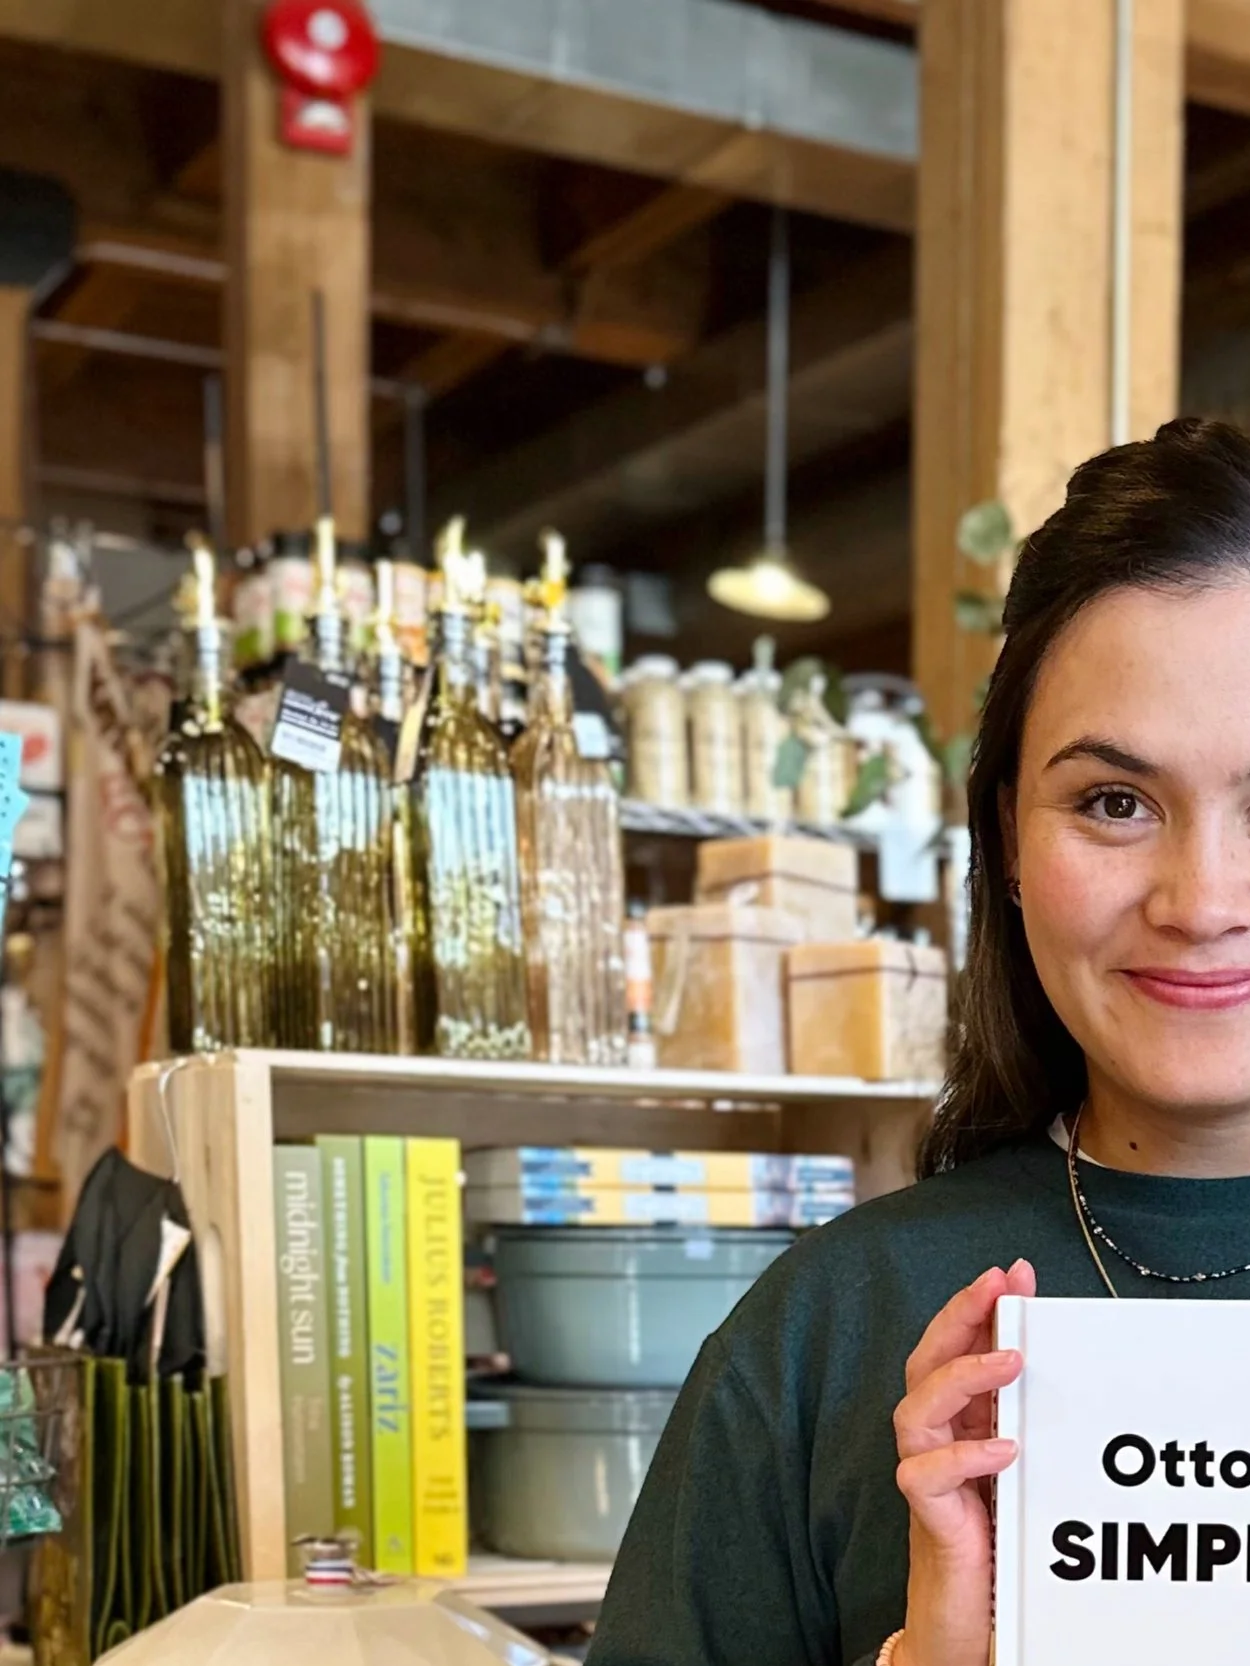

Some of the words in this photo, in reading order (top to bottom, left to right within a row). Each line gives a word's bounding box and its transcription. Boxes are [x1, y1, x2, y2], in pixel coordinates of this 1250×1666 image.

[280, 1171, 320, 1303] midnight
[418, 1173, 449, 1288] JULIUS
[290, 1308, 315, 1365] sun
[426, 1298, 451, 1442] ROBERTS
